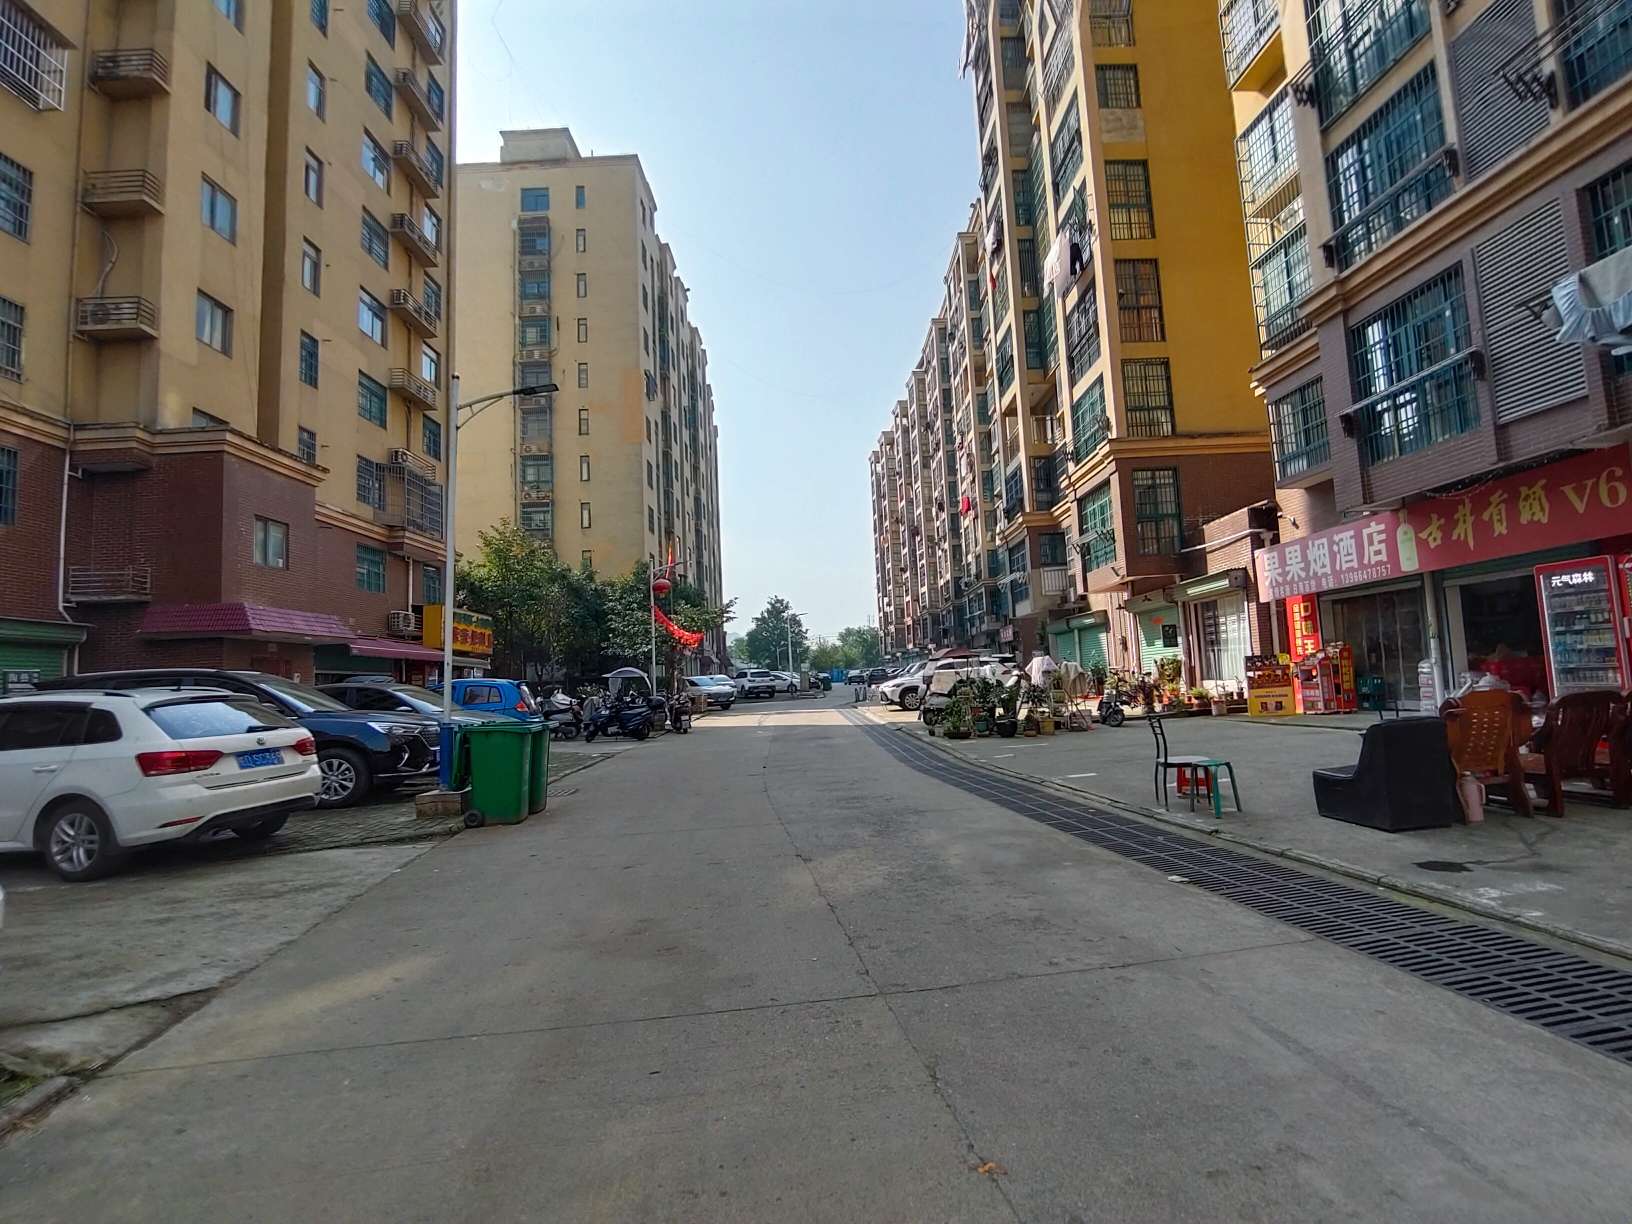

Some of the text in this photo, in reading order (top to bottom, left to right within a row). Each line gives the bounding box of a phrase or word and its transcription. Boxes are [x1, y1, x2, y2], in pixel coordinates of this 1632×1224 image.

[1560, 466, 1627, 514] V6
[1263, 521, 1388, 586] 果果烟酒店
[1551, 571, 1595, 587] 元气森林
